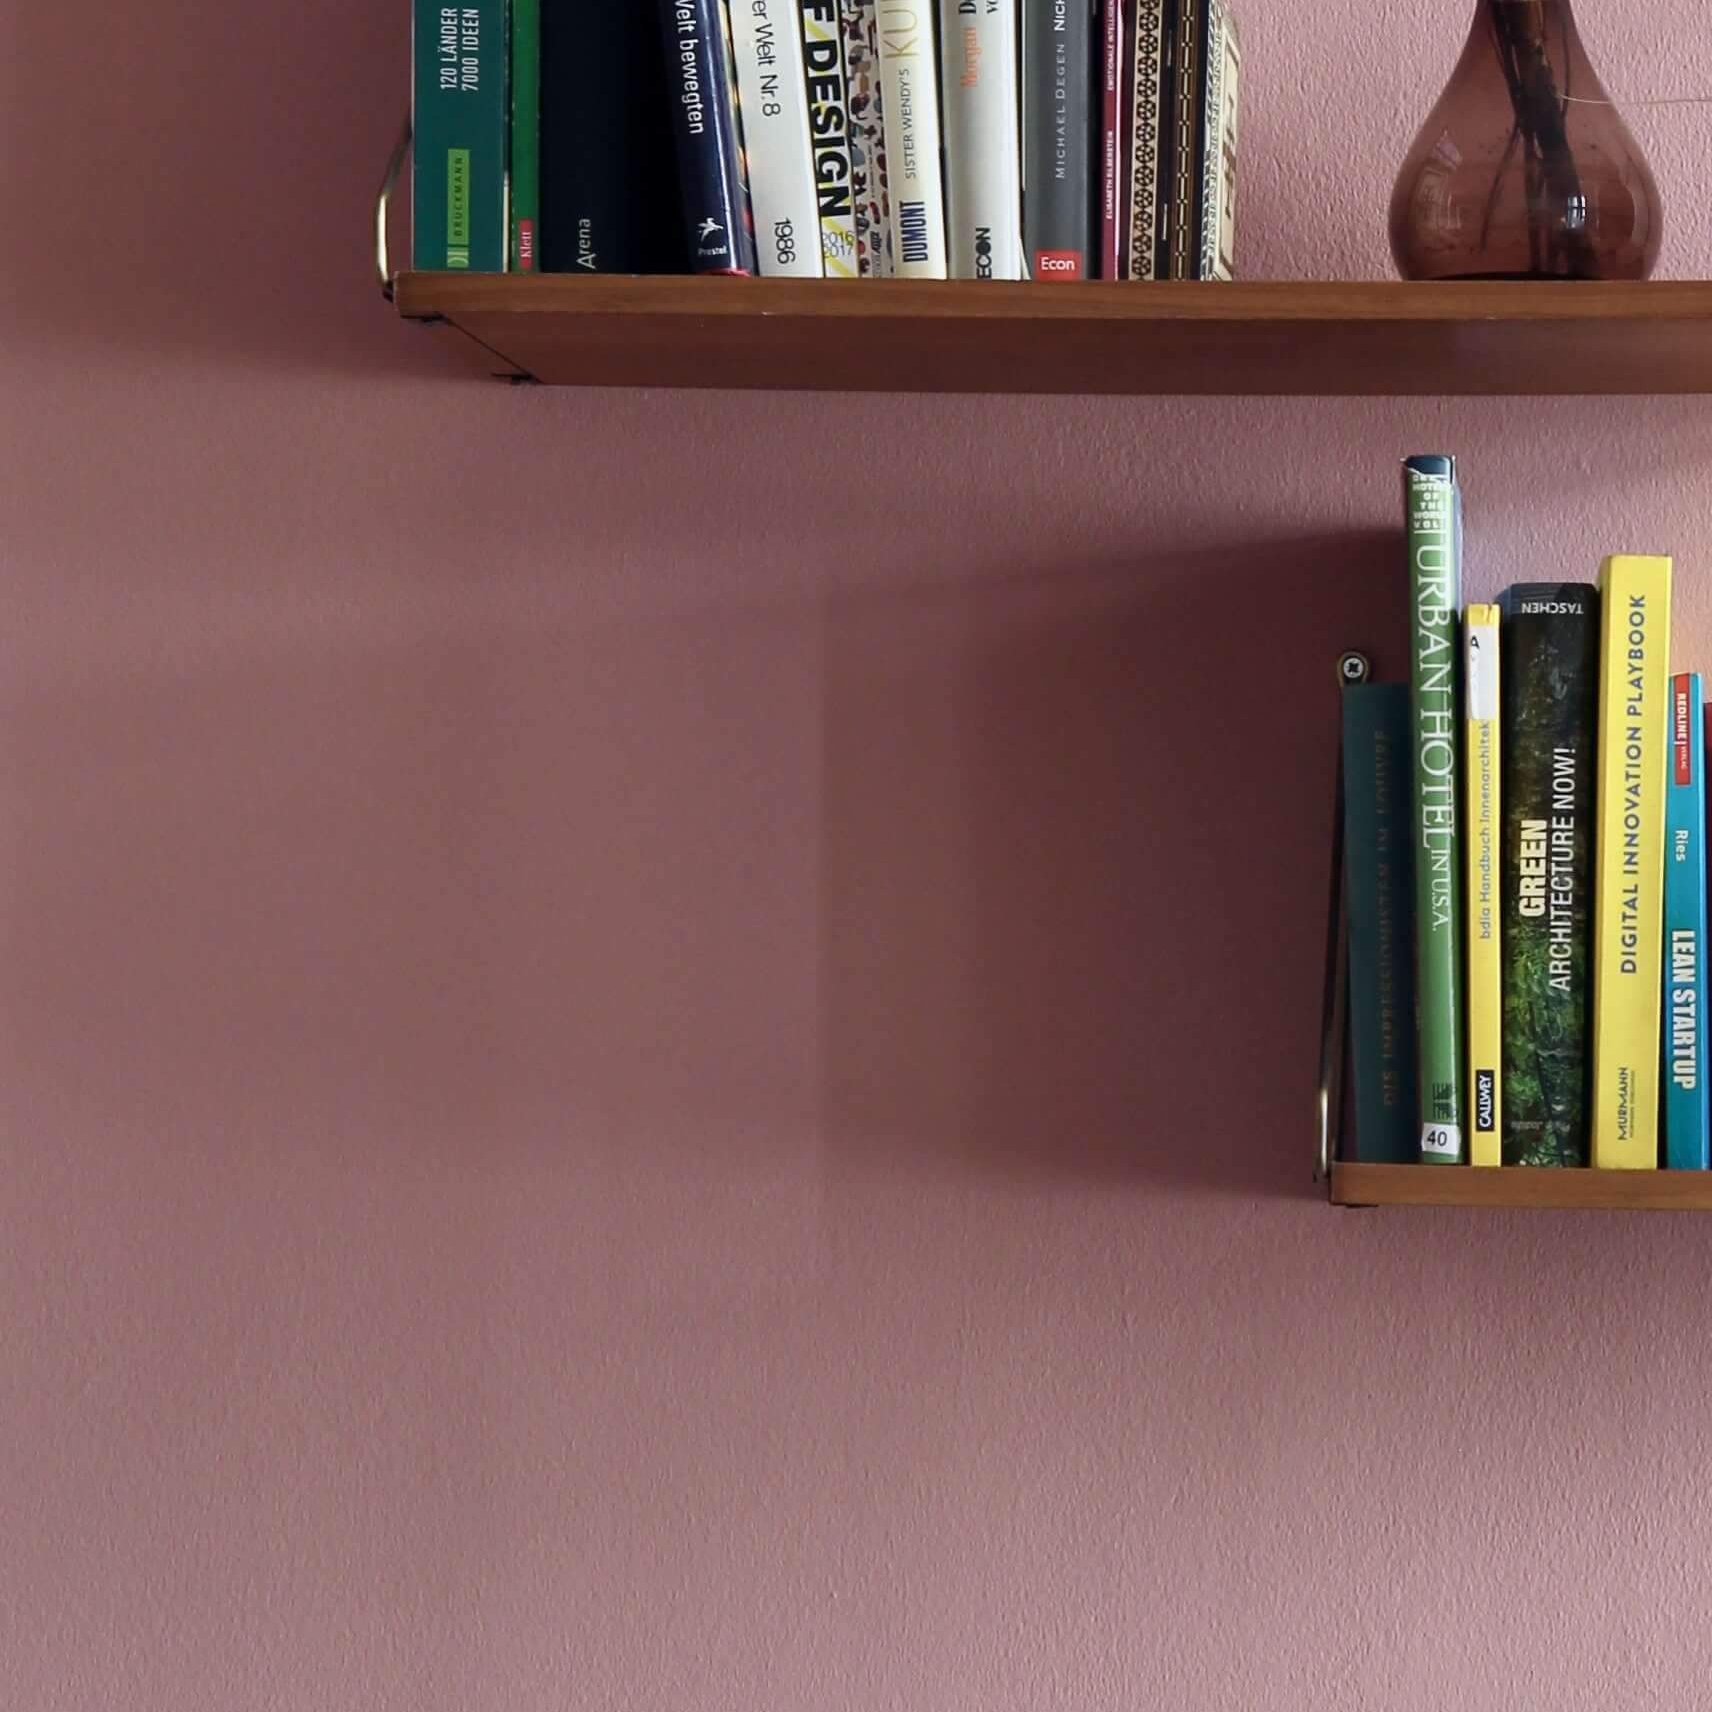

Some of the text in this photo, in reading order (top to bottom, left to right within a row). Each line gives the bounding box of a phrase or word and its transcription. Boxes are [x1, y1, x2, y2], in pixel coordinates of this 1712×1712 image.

[437, 7, 458, 90] 120 LÄNDER
[462, 8, 479, 90] 7000 IDEEN
[754, 23, 776, 66] Welt
[960, 27, 982, 88] Morgan
[1055, 43, 1066, 99] DEGEN
[679, 39, 705, 134] bewegten
[899, 69, 914, 128] WENDY'S
[805, 40, 852, 217] DESIGN
[904, 131, 917, 179] SISTER
[1055, 104, 1066, 179] MICHAEL
[453, 157, 463, 237] BRUCKMANN
[519, 232, 533, 259] Klett
[576, 218, 597, 269] Arena
[774, 218, 796, 264] 1986
[899, 200, 929, 263] DUMONT
[975, 227, 992, 278] ECON
[1040, 256, 1075, 273] Econ
[1416, 544, 1453, 695] URBAN
[1521, 601, 1584, 615] TASCHEN
[1676, 693, 1688, 739] REDLINE
[1420, 708, 1455, 849] HOTEL
[1621, 593, 1647, 974] DIGITAL INNOVATION PLAYBOOK
[1479, 720, 1493, 940] bdia Handbuch Innenarchitek
[1675, 830, 1689, 863] Ries
[1430, 849, 1450, 878] IN
[1519, 819, 1548, 918] GREEN
[1548, 747, 1578, 993] ARCHITECTURE NOW!
[1671, 929, 1697, 1090] LEAN STARTUP
[1478, 1074, 1494, 1128] CALLWEY
[1617, 1067, 1629, 1142] MURMANN
[1426, 1129, 1449, 1148] 40
